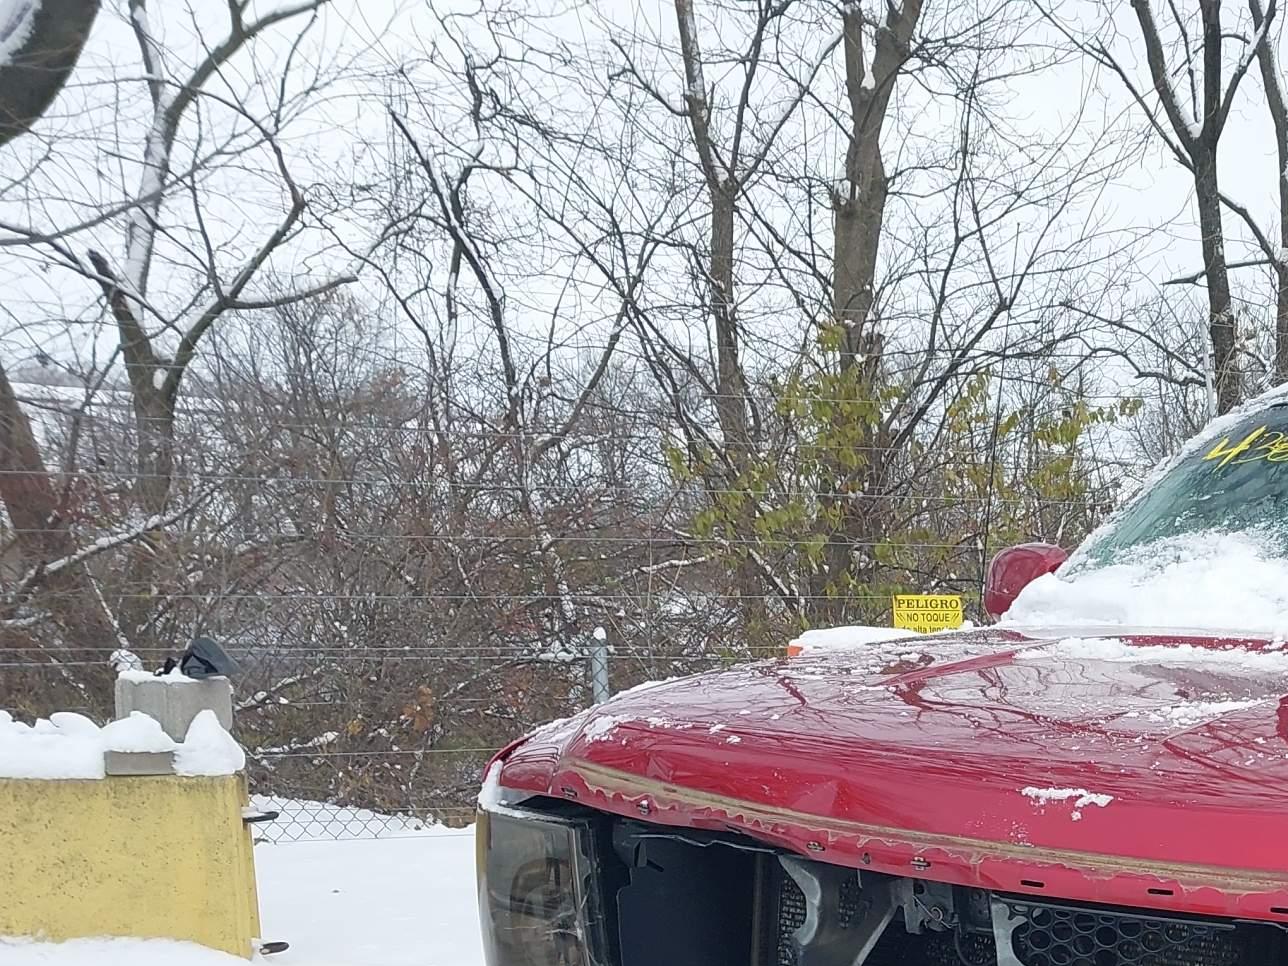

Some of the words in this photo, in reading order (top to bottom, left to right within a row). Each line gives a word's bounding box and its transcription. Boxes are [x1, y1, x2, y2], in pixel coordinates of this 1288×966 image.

[897, 598, 959, 609] PELIGRO
[906, 613, 919, 622] NO
[921, 613, 951, 622] TOQUE
